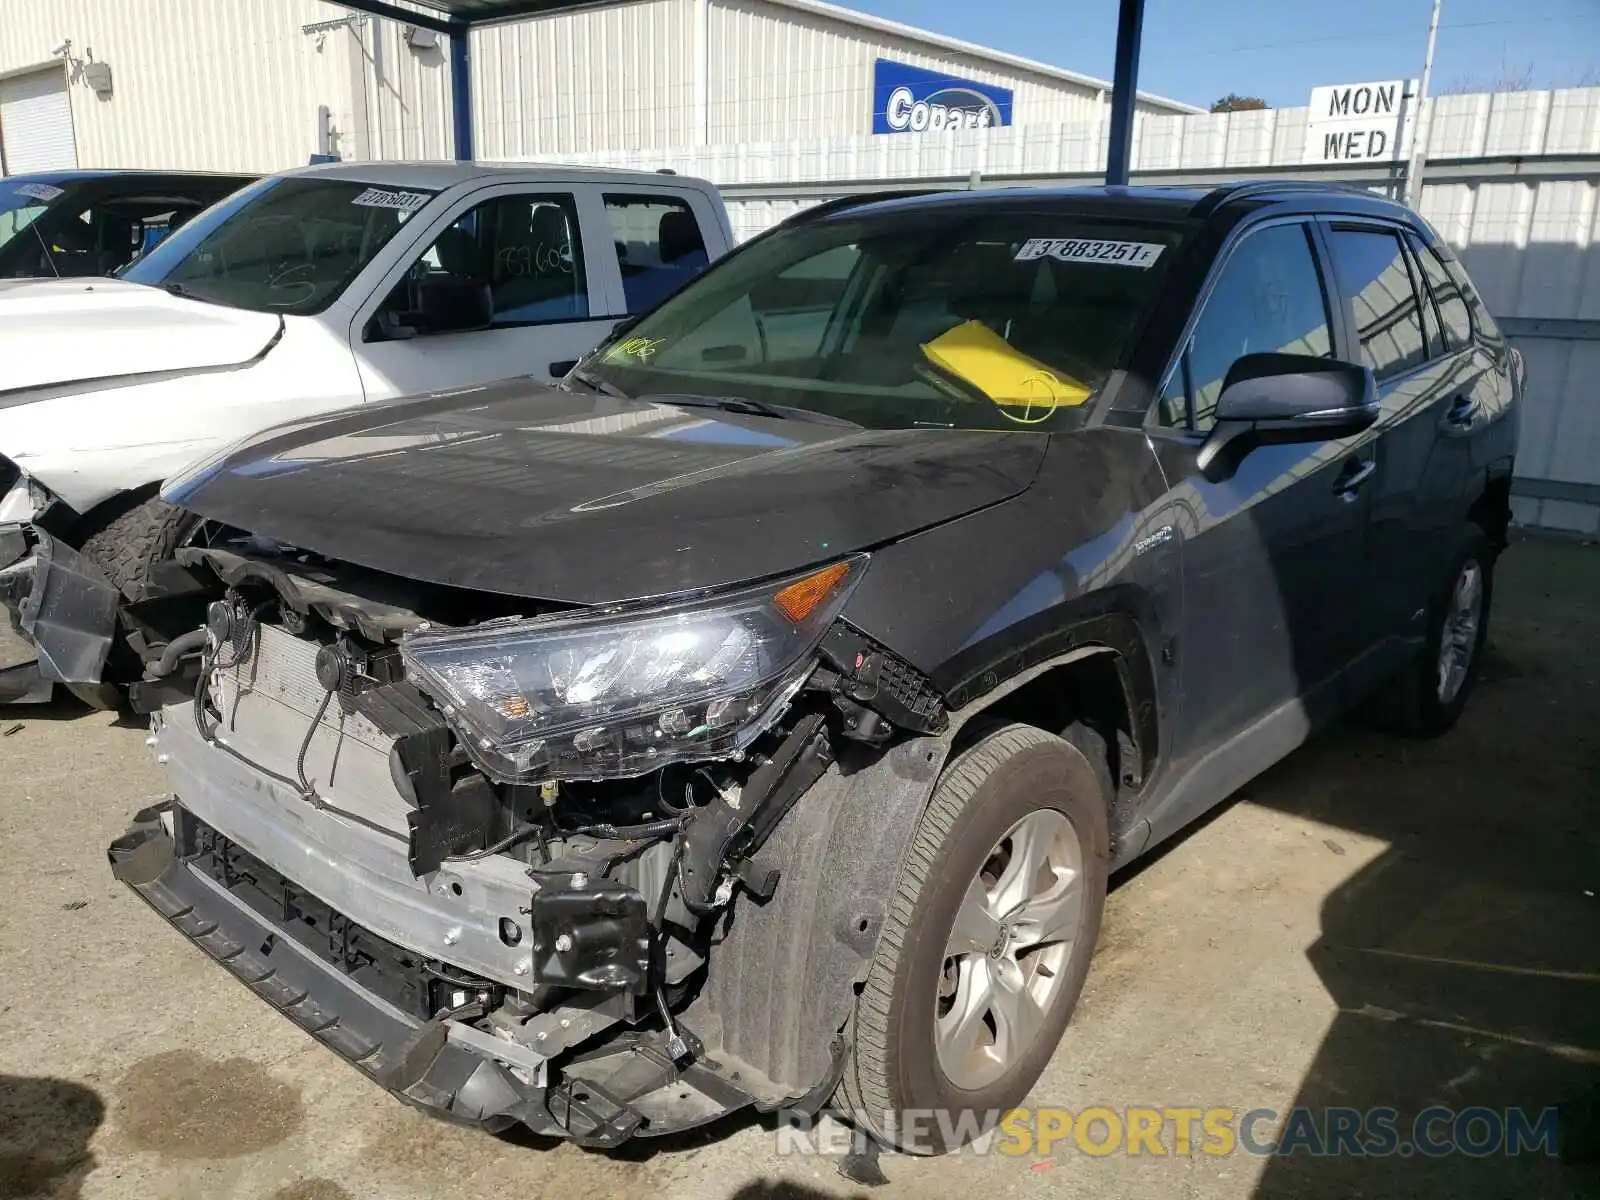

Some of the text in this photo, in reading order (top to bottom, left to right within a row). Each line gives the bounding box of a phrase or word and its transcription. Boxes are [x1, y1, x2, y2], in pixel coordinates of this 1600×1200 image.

[1329, 85, 1395, 116] MON
[1324, 130, 1386, 160] WED
[1035, 240, 1143, 261] 37883251
